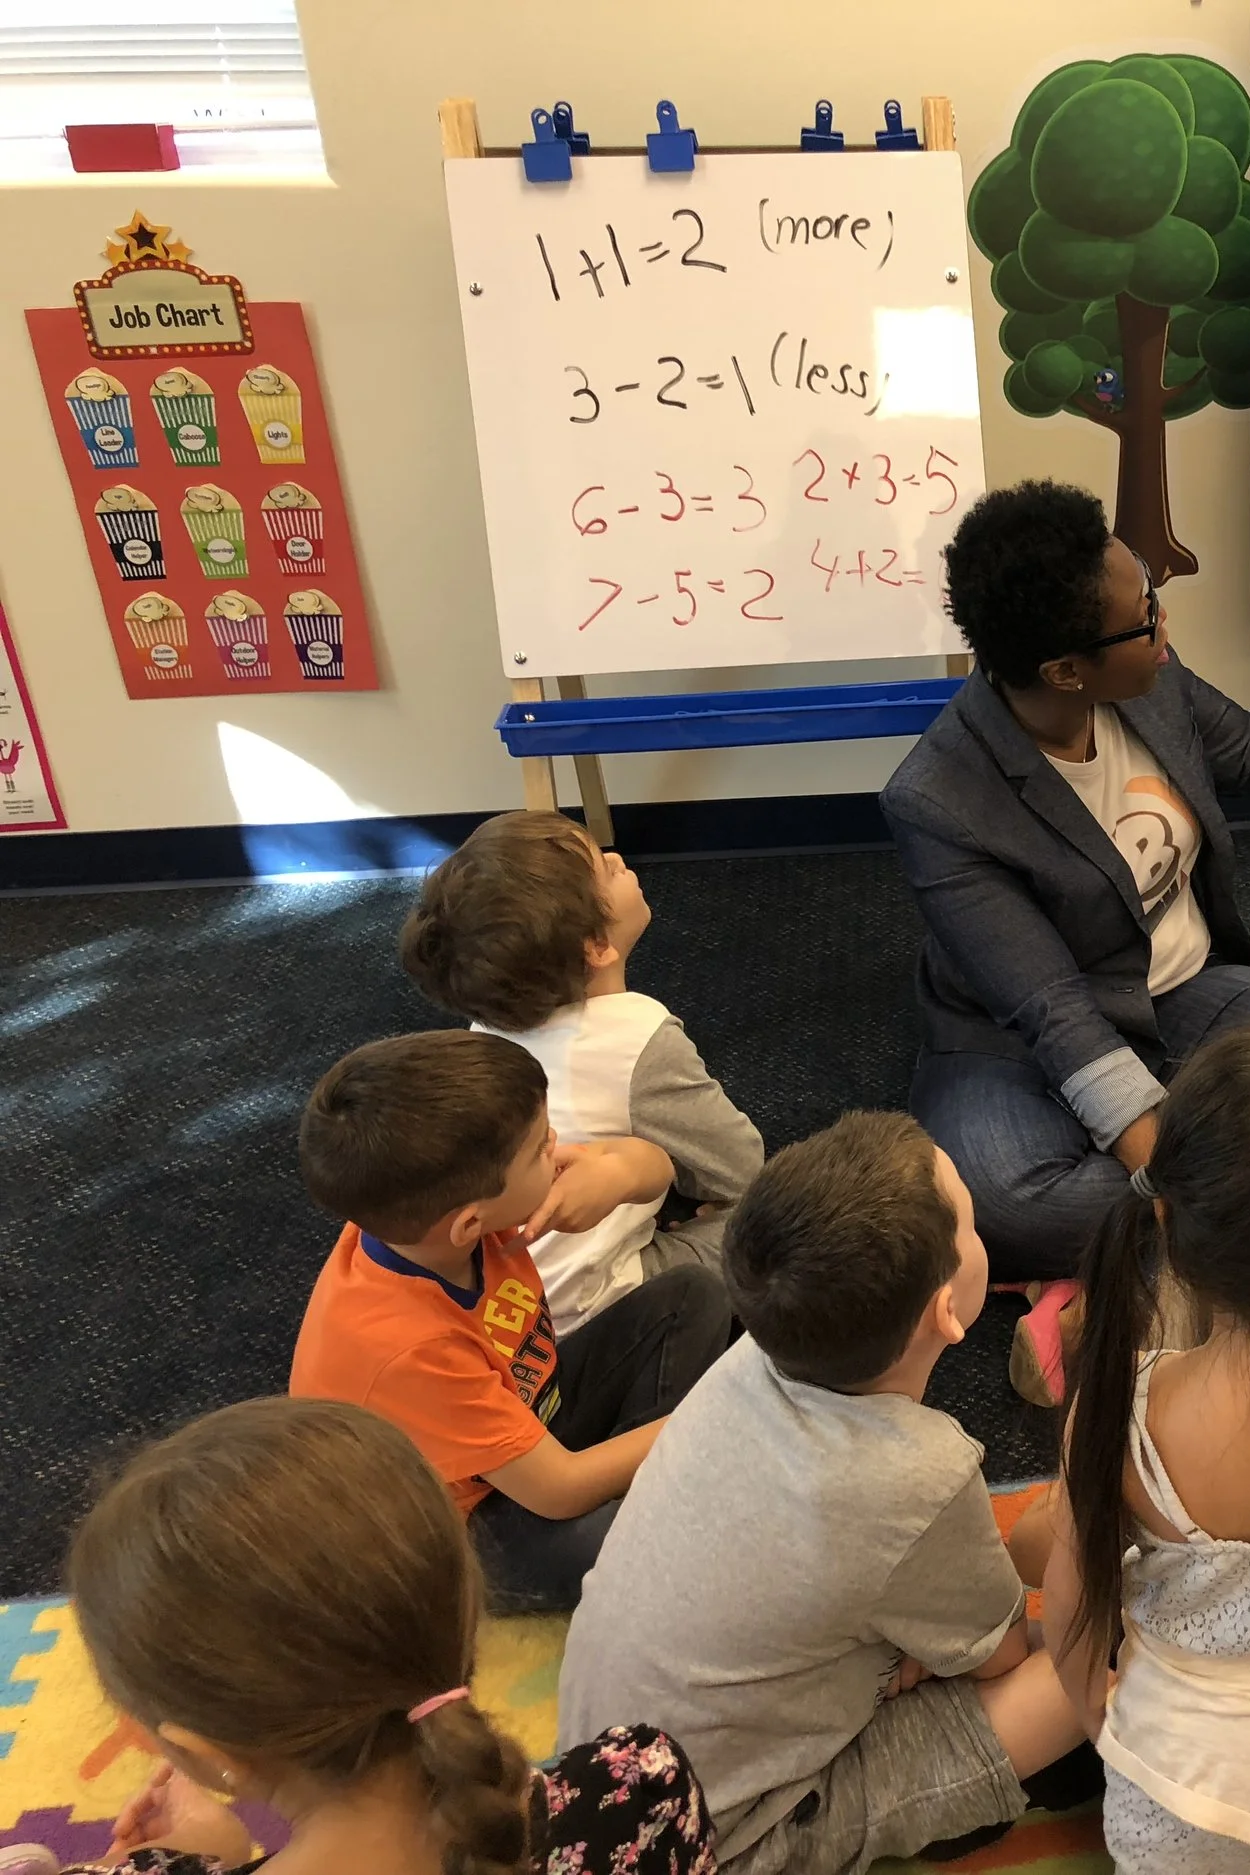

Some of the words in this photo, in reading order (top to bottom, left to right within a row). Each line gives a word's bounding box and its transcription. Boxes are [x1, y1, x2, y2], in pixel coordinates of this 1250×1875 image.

[758, 197, 895, 269] (more)
[109, 304, 151, 329] Job
[156, 302, 224, 328] Chart
[267, 430, 289, 440] Lights
